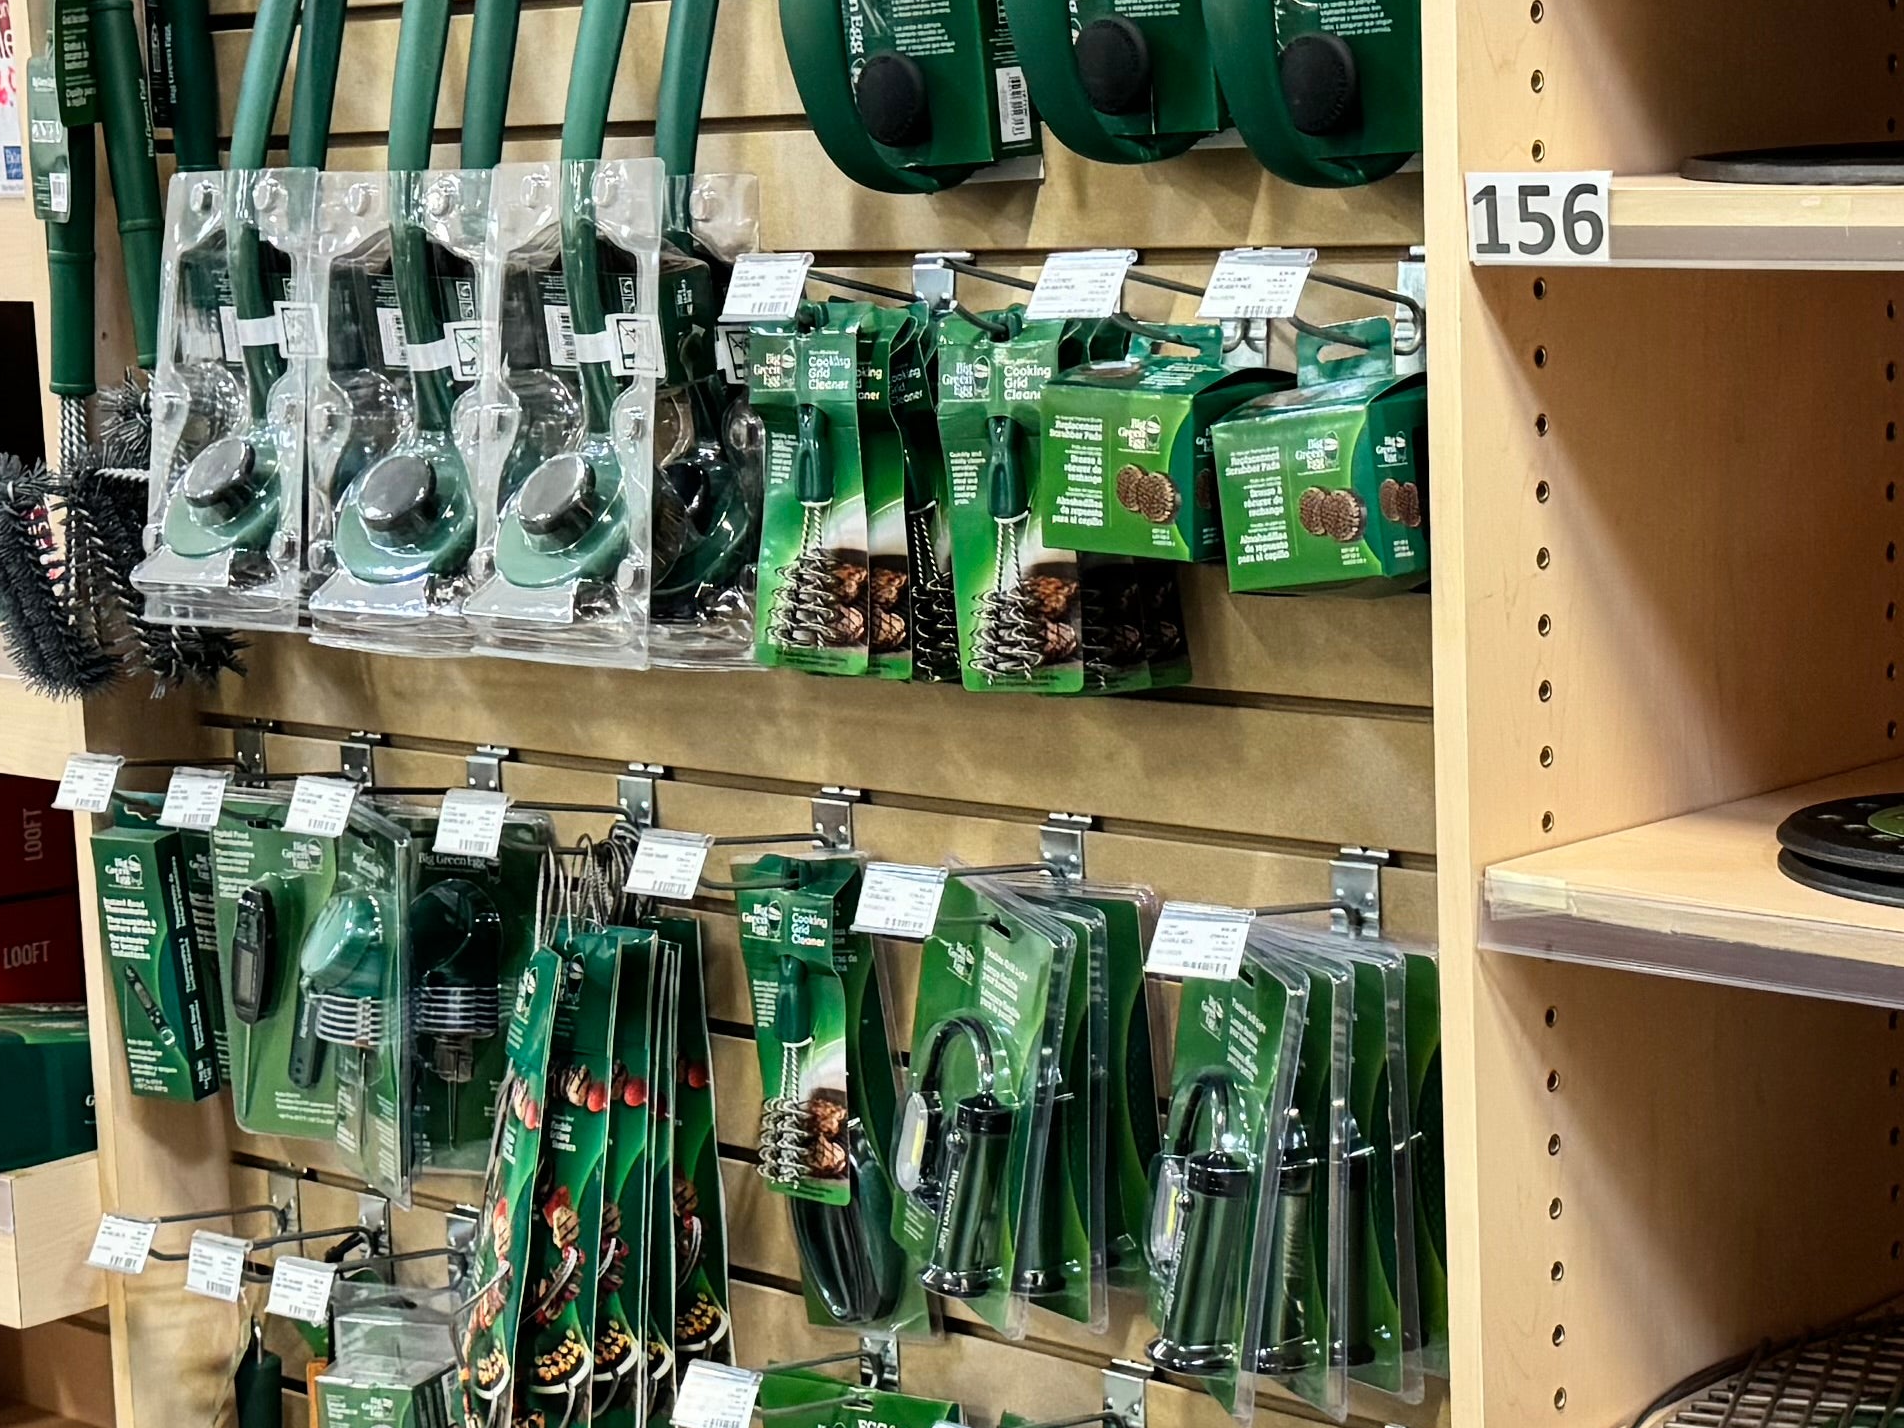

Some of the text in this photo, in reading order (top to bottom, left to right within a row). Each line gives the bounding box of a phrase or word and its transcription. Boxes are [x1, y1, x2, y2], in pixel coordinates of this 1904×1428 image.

[1472, 183, 1604, 257] 156
[808, 355, 851, 370] Cooking
[808, 378, 849, 390] Cleaner
[3, 940, 51, 970] LOOFT
